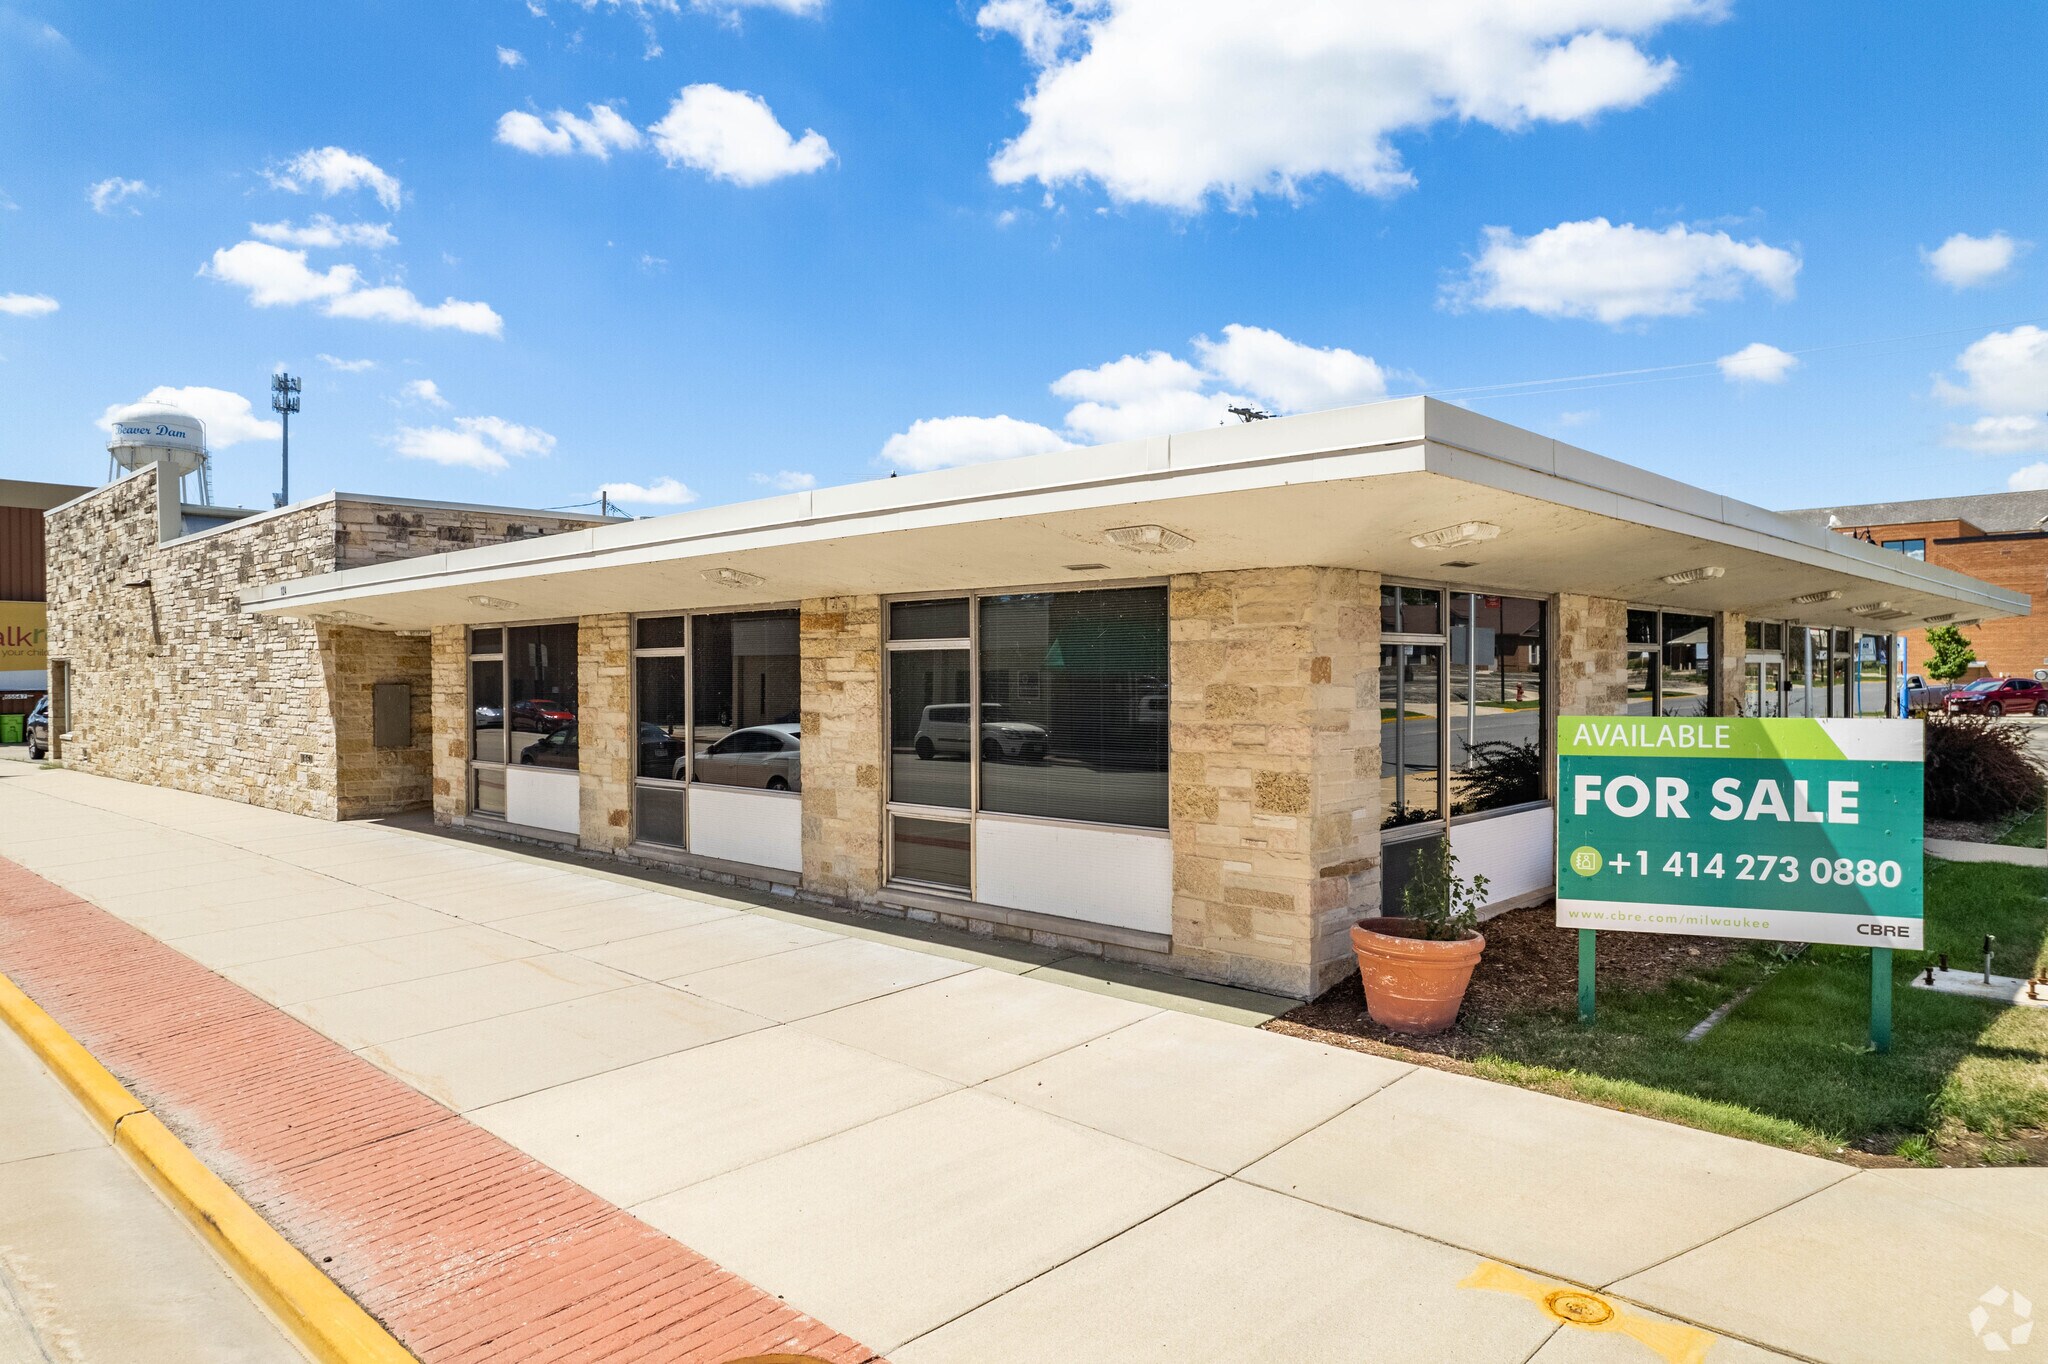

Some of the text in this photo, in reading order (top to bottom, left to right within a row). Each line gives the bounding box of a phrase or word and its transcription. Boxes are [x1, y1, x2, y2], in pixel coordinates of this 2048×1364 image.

[116, 423, 186, 438] Beaver Dam
[2, 649, 24, 657] your
[1572, 723, 1731, 749] AVAILABLE
[1574, 774, 1859, 825] FOR SALE
[1608, 850, 1902, 888] +1 414 273 0880
[1568, 910, 1771, 930] www.cbre.com/milwaukee
[1856, 923, 1910, 938] CBRE
